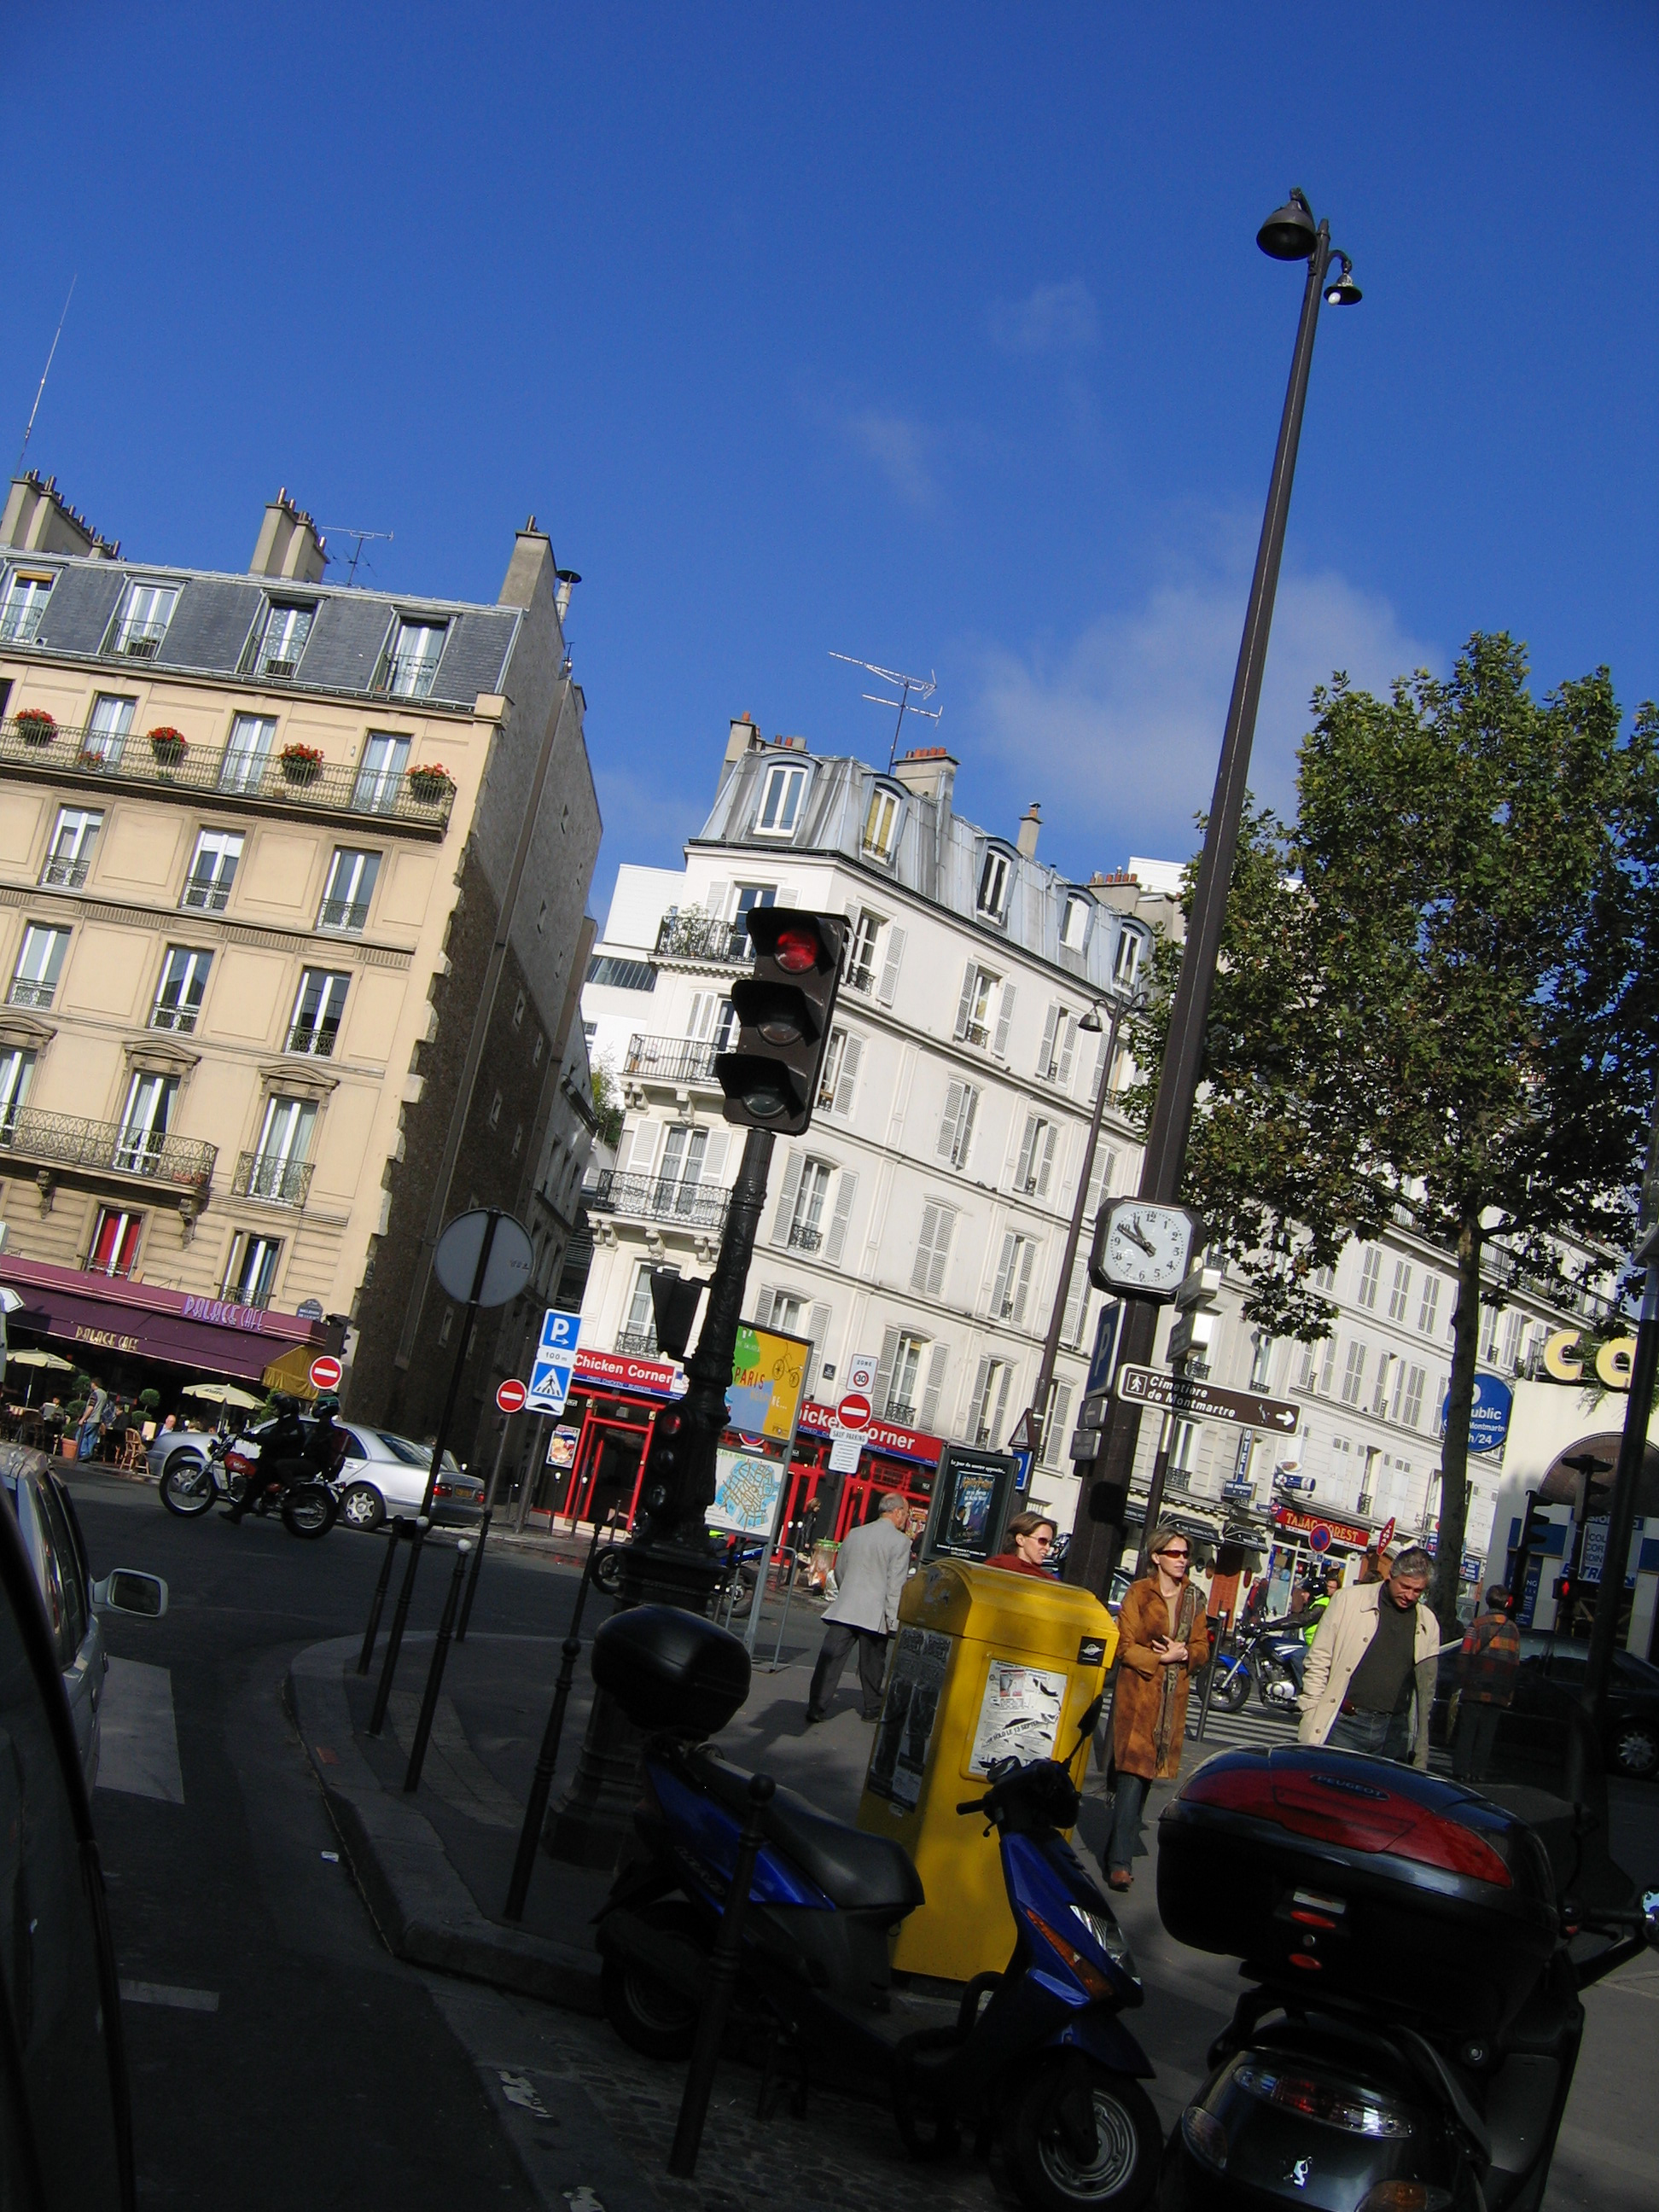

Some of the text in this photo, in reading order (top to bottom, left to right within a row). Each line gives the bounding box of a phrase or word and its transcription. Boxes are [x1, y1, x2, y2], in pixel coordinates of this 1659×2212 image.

[1146, 1213, 1156, 1223] 12
[1164, 1220, 1168, 1230] 1
[1114, 1237, 1121, 1246] 9
[1171, 1231, 1179, 1242] 2
[1115, 1252, 1122, 1260] 8
[1173, 1247, 1180, 1256] 3
[1126, 1263, 1133, 1272] 7
[1166, 1260, 1173, 1270] 4
[1138, 1271, 1145, 1280] 6
[1154, 1268, 1161, 1278] 5
[183, 1295, 241, 1325] PALACE
[75, 1325, 116, 1347] PALACE
[550, 1318, 569, 1342] P
[545, 1352, 560, 1360] 100
[1093, 1323, 1110, 1377] P
[575, 1353, 673, 1384] Chicken Corner
[734, 1366, 765, 1389] PARIS
[857, 1373, 867, 1383] 30
[1147, 1388, 1236, 1417] de Montmartre
[1470, 1406, 1502, 1421] ublic
[832, 1429, 844, 1438] SAUF
[846, 1430, 865, 1442] PARKING
[867, 1423, 916, 1450] orner
[1468, 1433, 1493, 1445] h/24
[1238, 1429, 1252, 1476] OTEL
[1286, 1512, 1359, 1542] TABAC OREST
[1317, 1775, 1381, 1796] PEUGEOT
